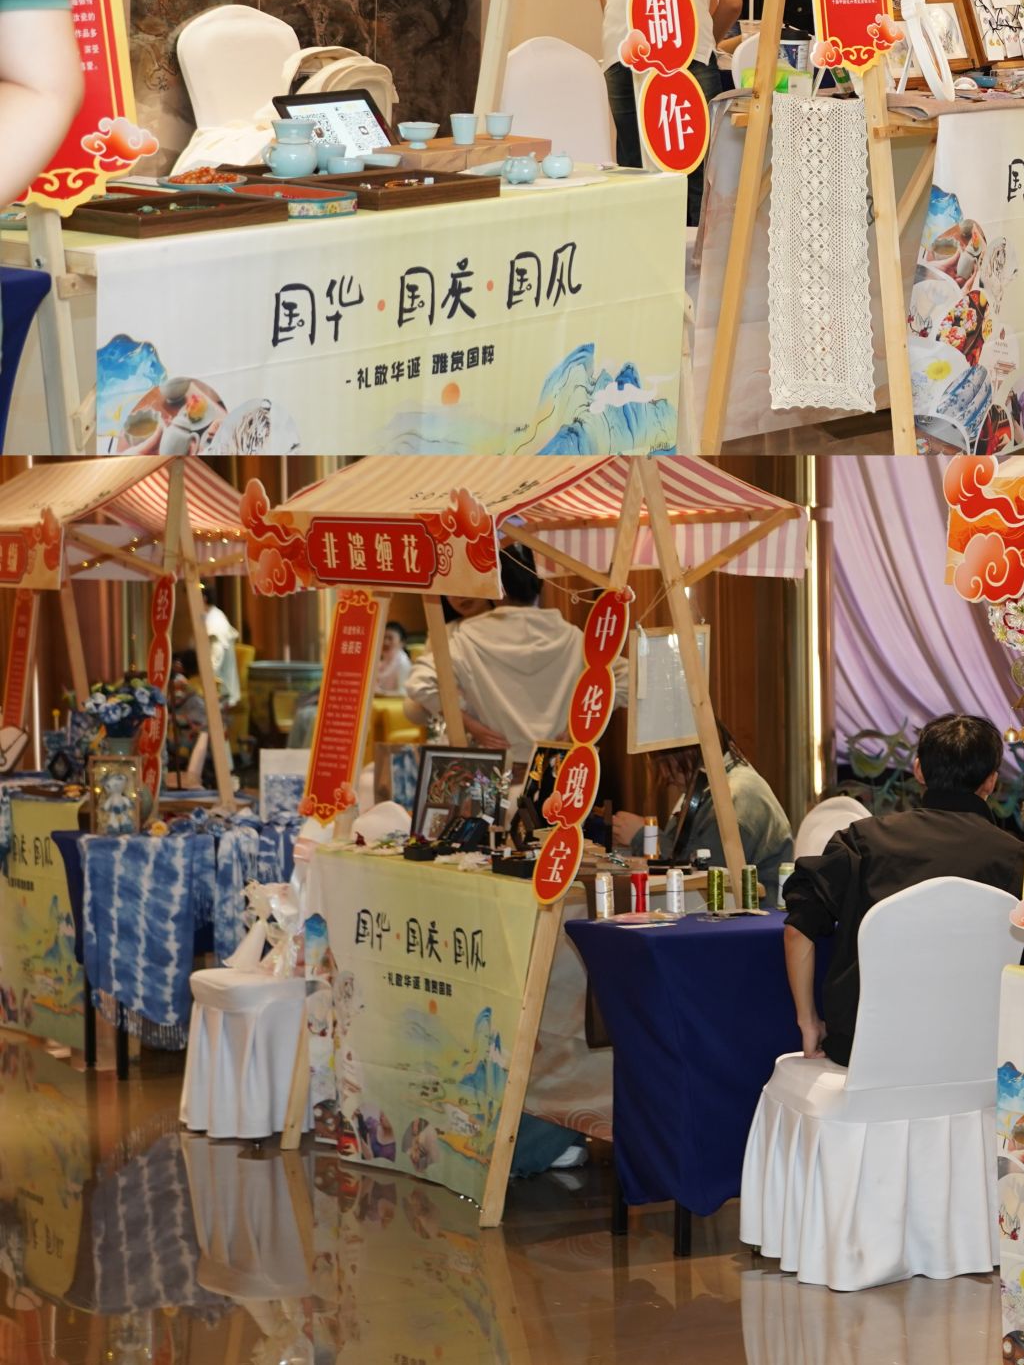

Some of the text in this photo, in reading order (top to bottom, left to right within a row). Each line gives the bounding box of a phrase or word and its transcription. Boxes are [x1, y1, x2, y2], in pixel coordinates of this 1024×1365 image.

[431, 345, 496, 375] 雅赏国粹
[321, 531, 421, 574] 非遗缠花
[541, 606, 618, 884] 中华瑰宝
